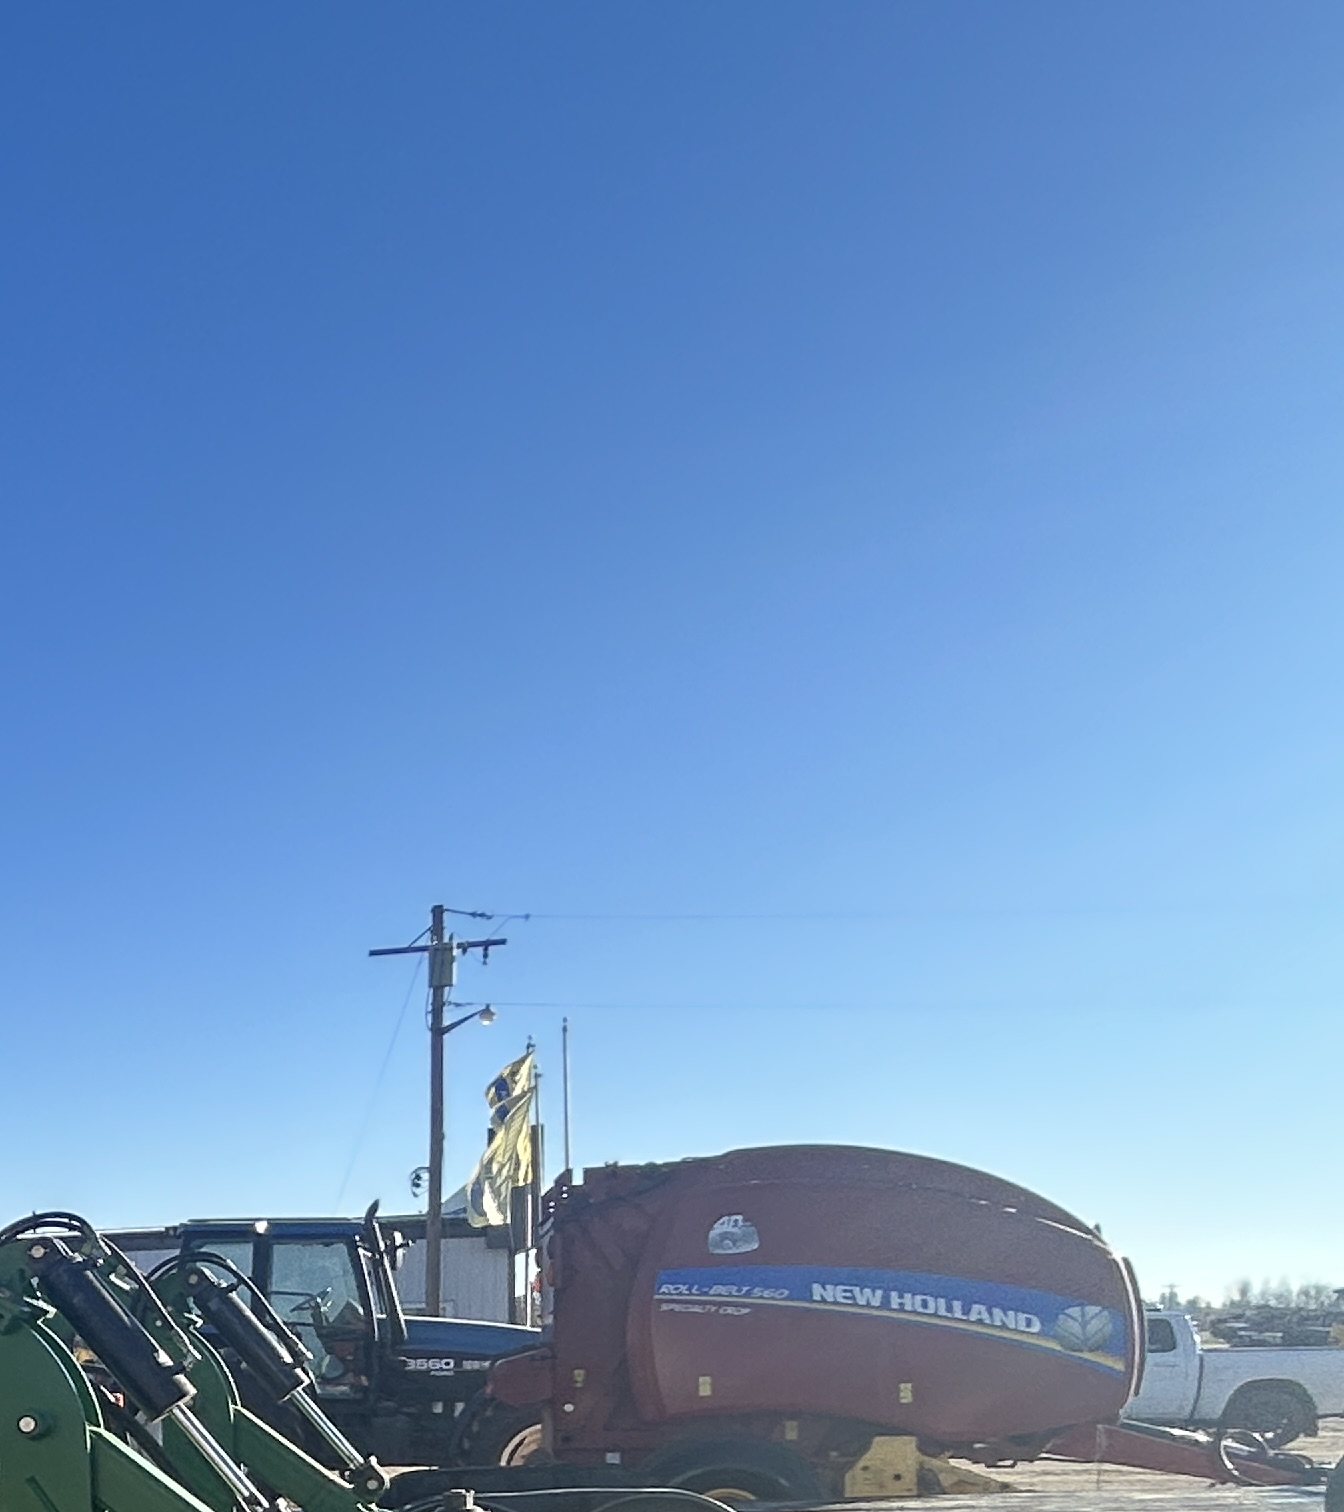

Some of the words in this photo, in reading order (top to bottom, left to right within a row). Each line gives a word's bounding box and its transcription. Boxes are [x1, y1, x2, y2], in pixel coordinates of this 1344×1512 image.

[751, 1286, 790, 1299] 560
[811, 1283, 883, 1307] NEW
[890, 1290, 1042, 1333] HOLLAND
